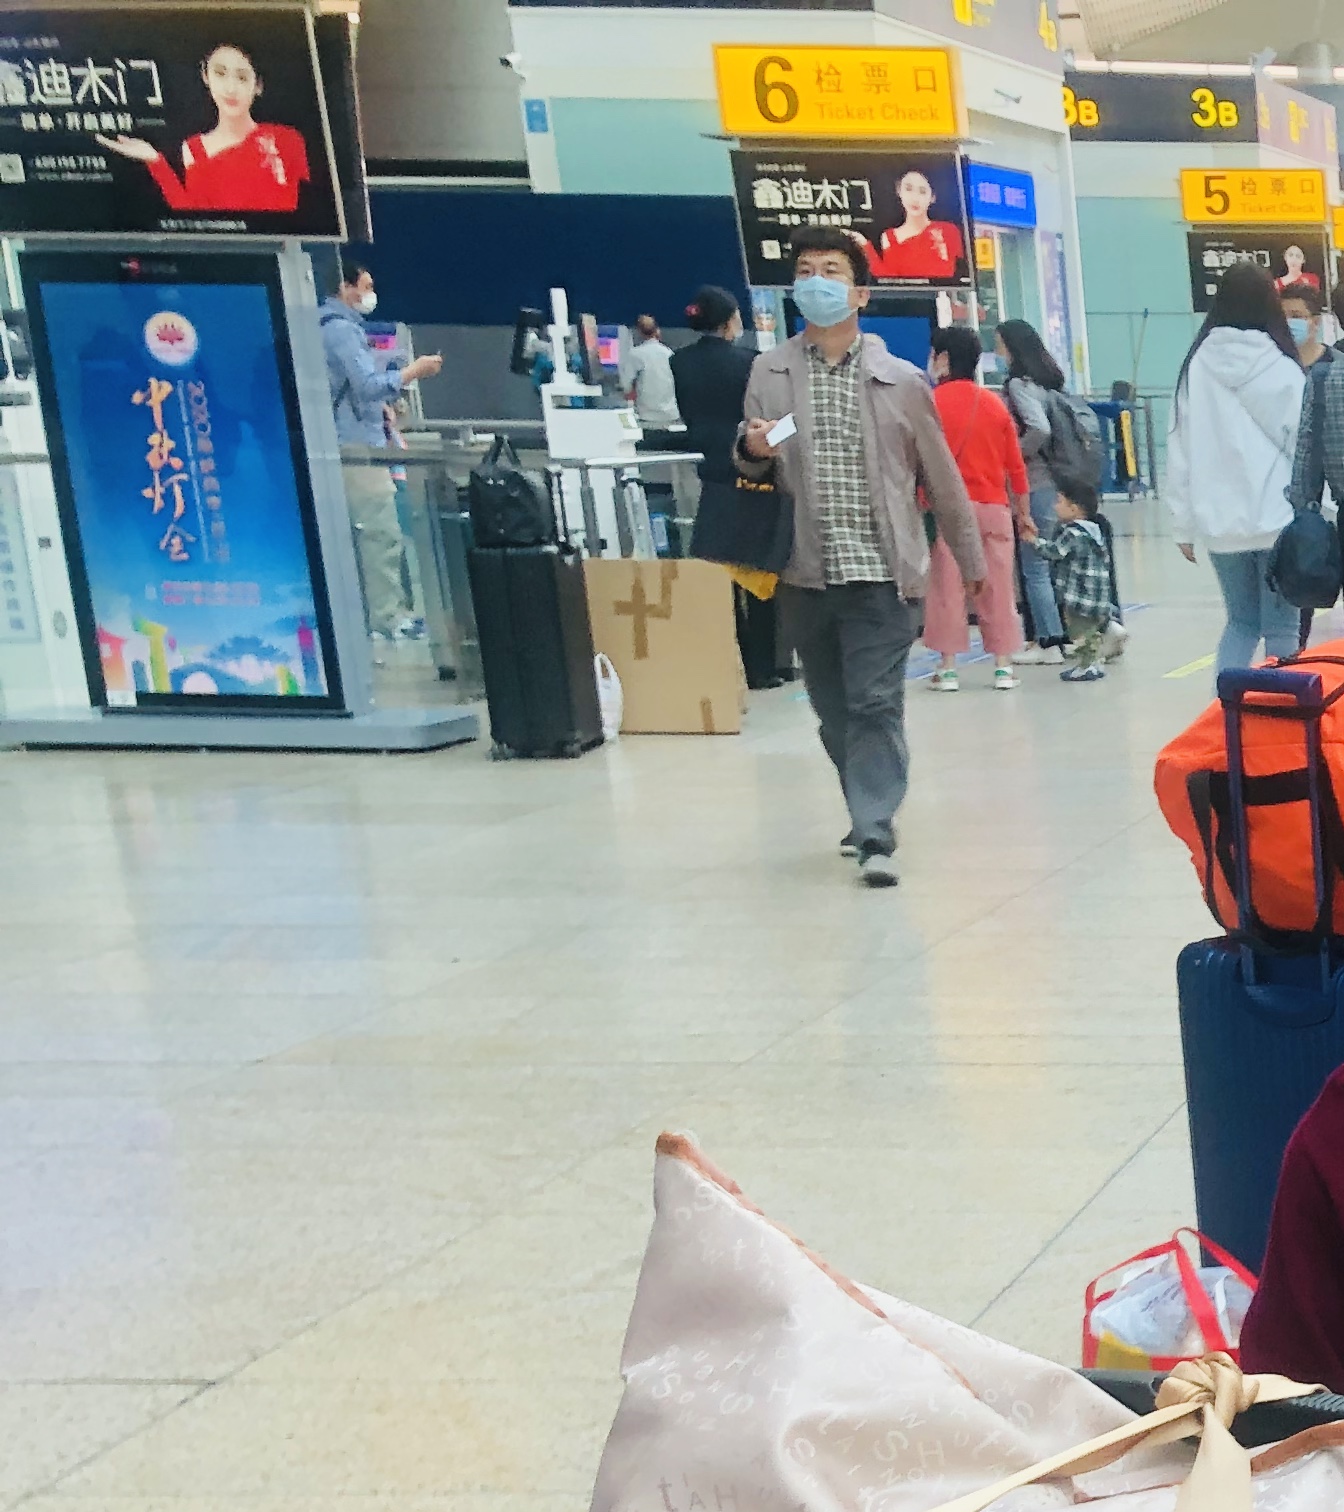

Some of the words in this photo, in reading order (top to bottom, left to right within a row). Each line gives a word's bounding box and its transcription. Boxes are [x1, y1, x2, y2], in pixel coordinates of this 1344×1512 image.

[754, 56, 799, 124] 6
[815, 61, 937, 94] 检票口
[817, 103, 875, 121] Ticket
[881, 103, 940, 121] Check
[1191, 88, 1239, 128] 3B
[1204, 175, 1230, 216] 5
[1241, 176, 1315, 196] 检票口
